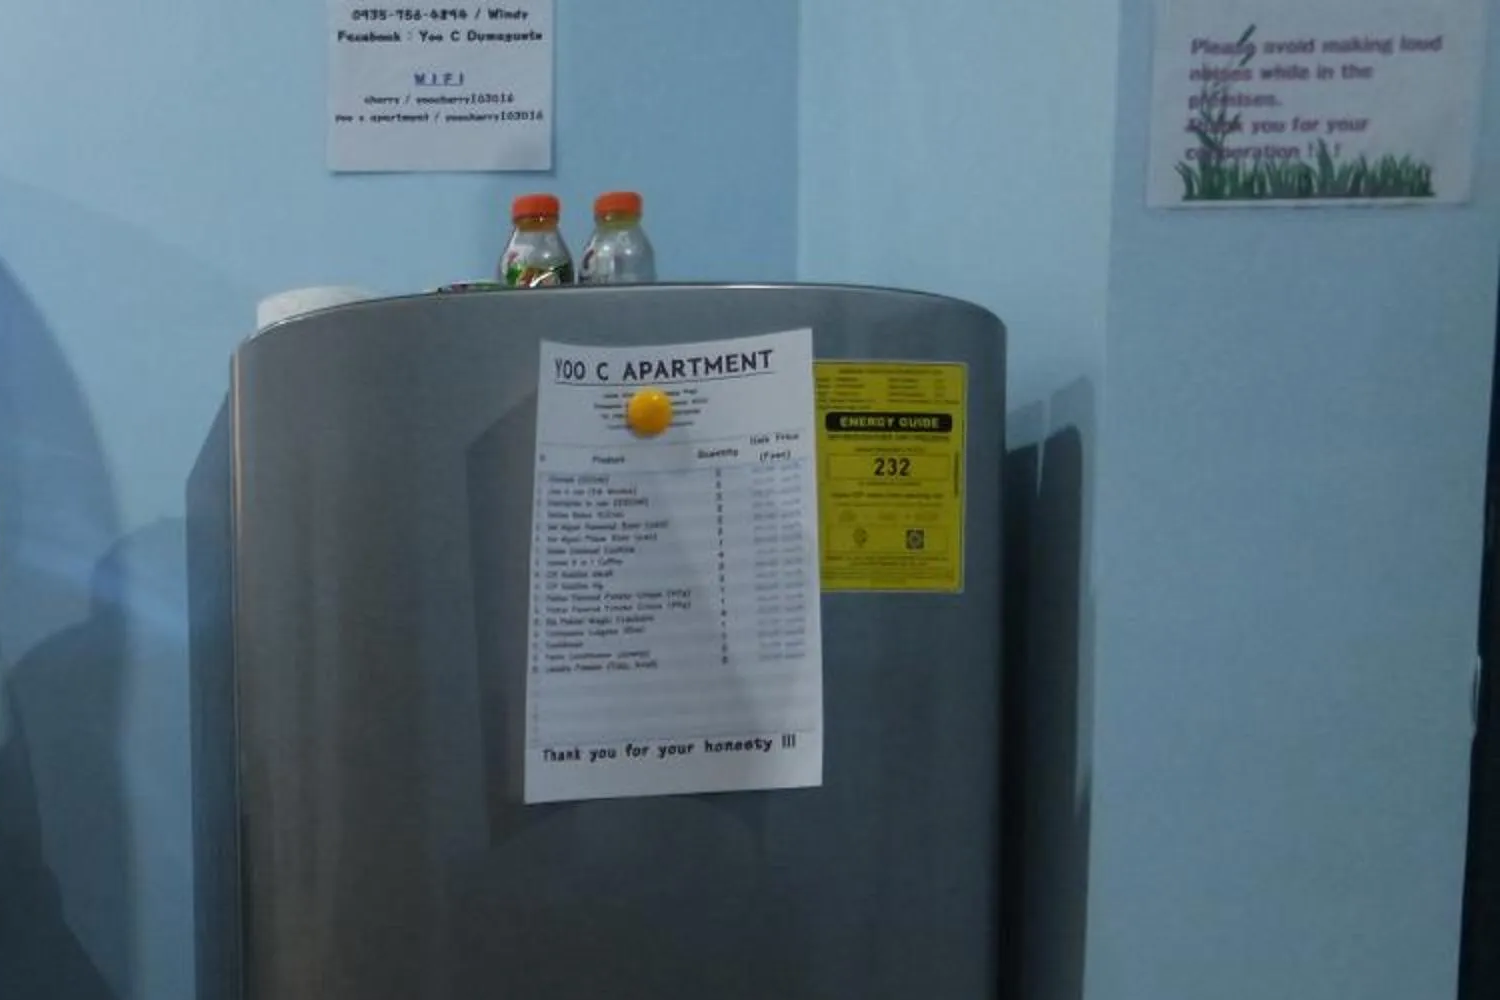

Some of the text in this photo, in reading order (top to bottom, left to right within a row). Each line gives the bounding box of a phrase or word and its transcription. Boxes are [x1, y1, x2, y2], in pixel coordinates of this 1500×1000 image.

[337, 30, 401, 42] Facebook
[419, 31, 443, 42] Yoo
[451, 30, 460, 42] C
[466, 30, 543, 43] Dumaguete
[1191, 35, 1443, 57] Please avoid making loud
[1260, 64, 1309, 81] while
[1316, 64, 1334, 80] in
[1341, 63, 1373, 79] the
[1251, 119, 1286, 136] you
[1292, 117, 1320, 133] for
[1326, 117, 1369, 135] your
[555, 349, 774, 382] YOO C APARTMENT
[840, 416, 939, 428] ENERGY GUIDE
[873, 458, 912, 476] 232
[543, 747, 581, 763] Thank
[588, 747, 617, 764] you
[625, 744, 648, 759] for
[657, 742, 694, 760] your
[703, 737, 773, 754] honesty
